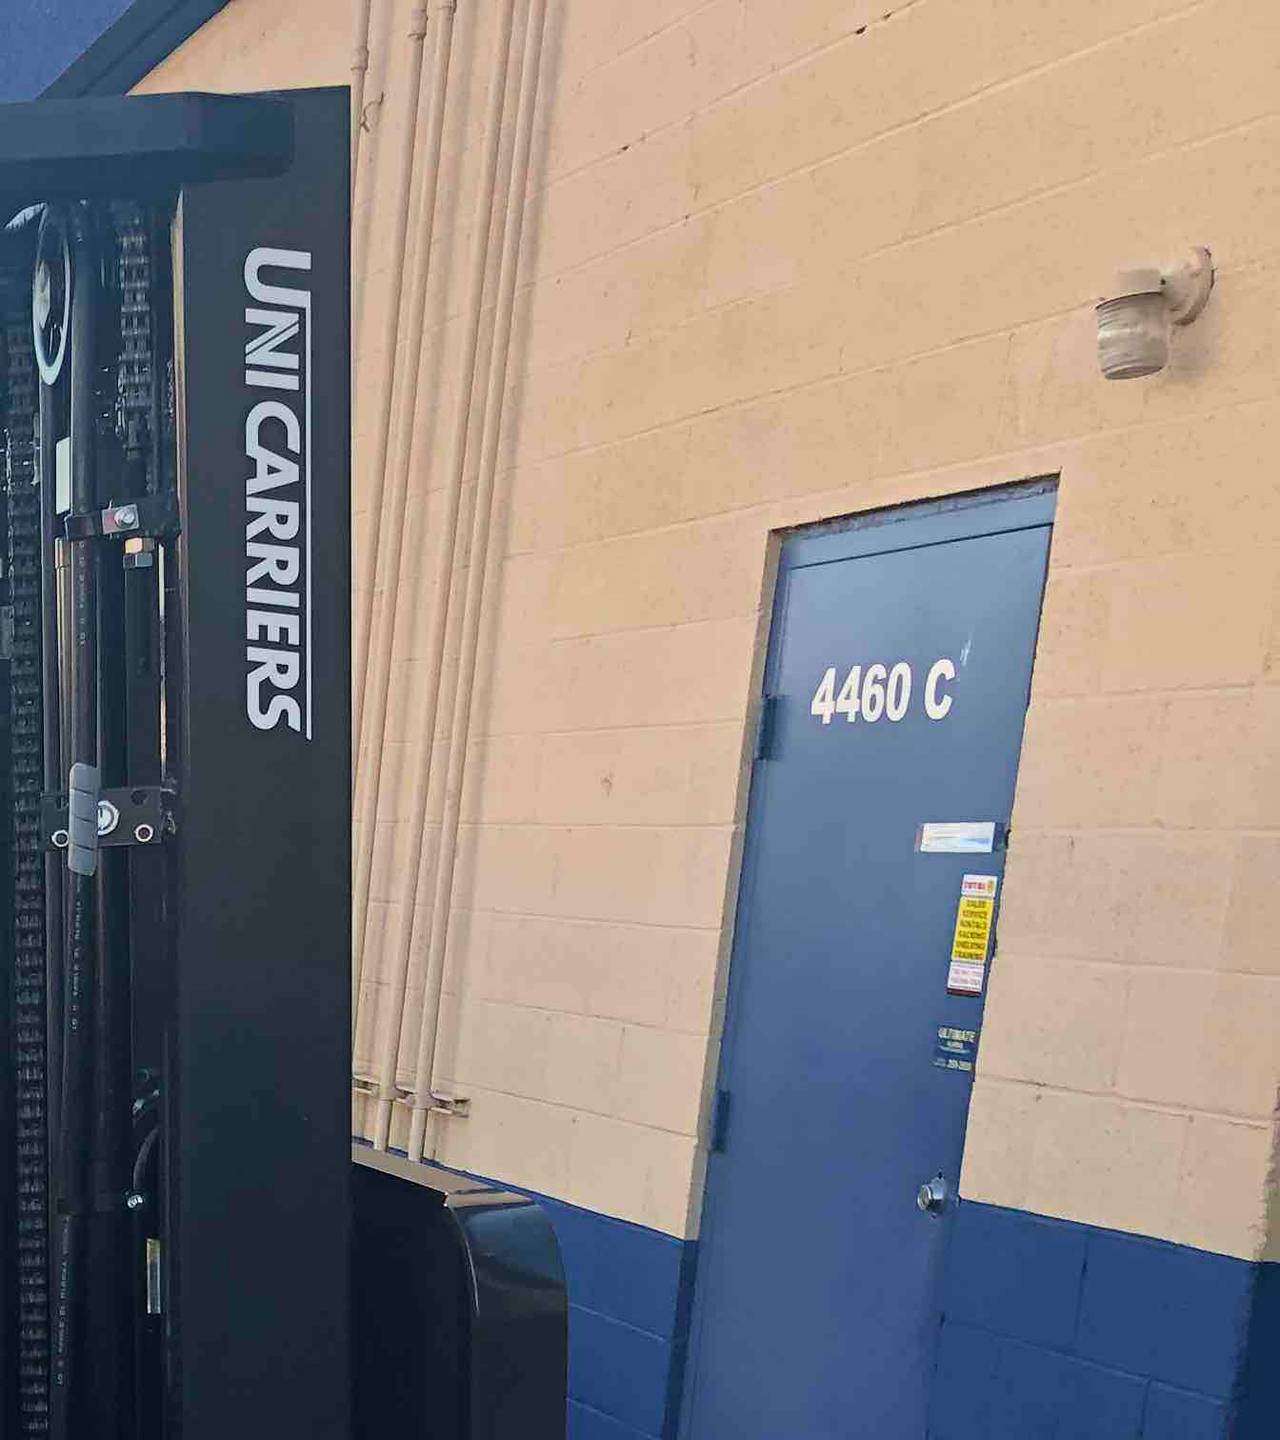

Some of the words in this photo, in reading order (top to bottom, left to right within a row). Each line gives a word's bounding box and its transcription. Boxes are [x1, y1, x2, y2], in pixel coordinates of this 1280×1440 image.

[244, 247, 311, 734] UNICARRIERS
[811, 663, 912, 724] 4460
[925, 658, 955, 720] C
[962, 910, 987, 919] SERVICE
